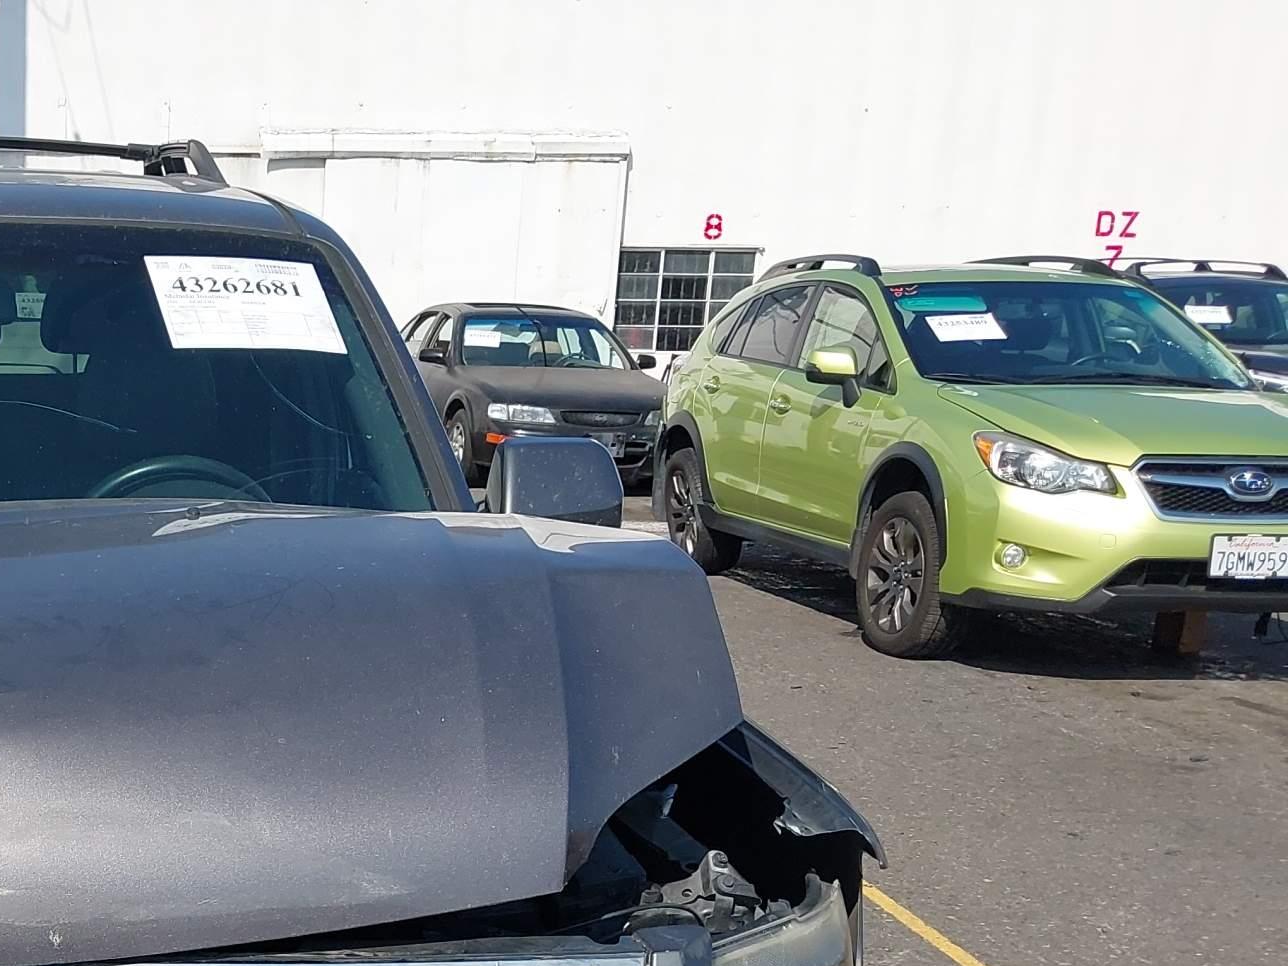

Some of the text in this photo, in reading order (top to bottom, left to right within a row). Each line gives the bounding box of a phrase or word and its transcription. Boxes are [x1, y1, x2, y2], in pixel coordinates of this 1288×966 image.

[704, 213, 723, 240] 8
[1095, 210, 1140, 238] DZ
[1105, 245, 1124, 269] 7
[171, 276, 304, 298] 43262681
[1216, 551, 1288, 572] 7GMW959
